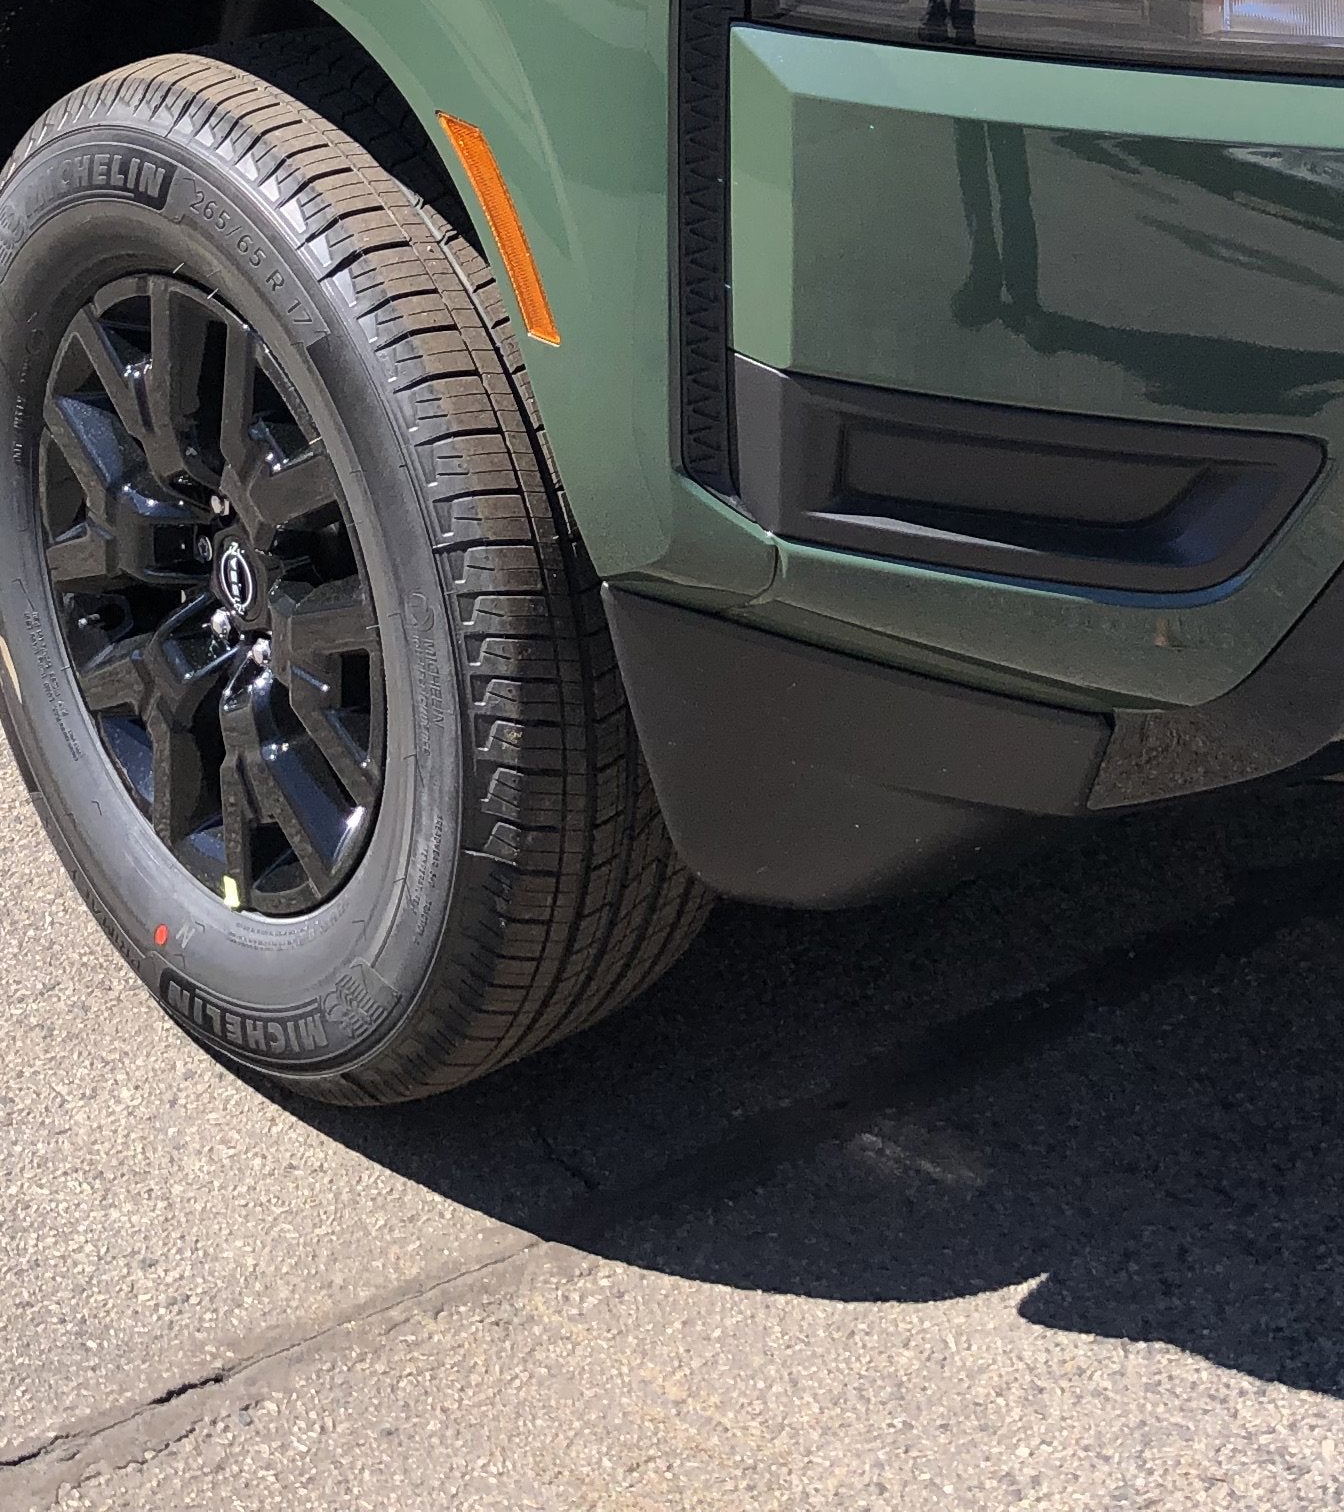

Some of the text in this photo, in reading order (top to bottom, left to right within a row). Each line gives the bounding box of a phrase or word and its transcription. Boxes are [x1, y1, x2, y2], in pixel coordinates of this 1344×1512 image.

[190, 190, 313, 325] 265/65 R 17
[168, 980, 329, 1055] MICHELIN
